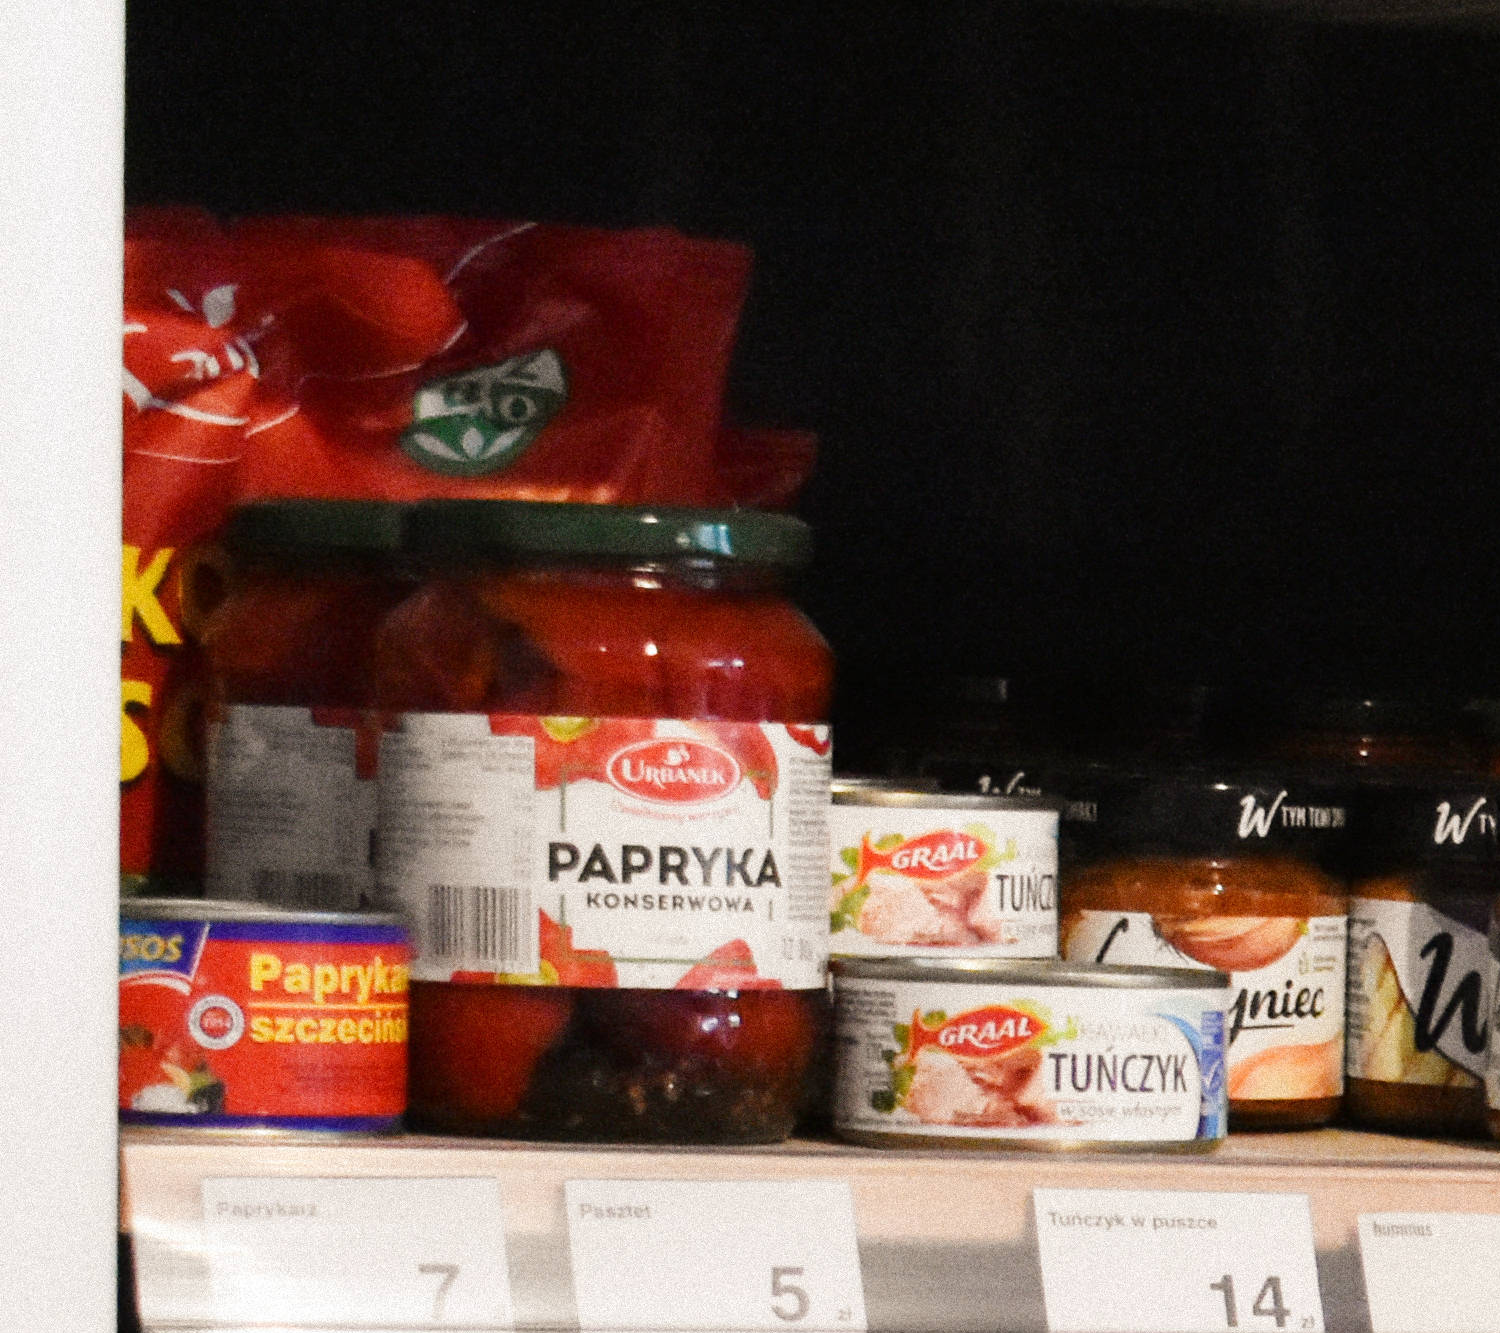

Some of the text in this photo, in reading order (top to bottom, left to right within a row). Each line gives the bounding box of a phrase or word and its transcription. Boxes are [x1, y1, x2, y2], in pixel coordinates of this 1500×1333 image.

[621, 758, 726, 790] URBANEK
[548, 841, 783, 889] PAPRYKA
[890, 836, 984, 872] GRAAL
[587, 892, 755, 913] KONSERWOWA
[938, 1015, 1034, 1057] GRAAL
[1048, 1044, 1190, 1094] TUŃCZYK
[579, 1203, 653, 1221] Pasztet
[1048, 1210, 1219, 1233] Tuńczyk w puszce
[417, 1262, 461, 1321] 7
[770, 1265, 811, 1323] 5
[1209, 1273, 1291, 1329] 14
